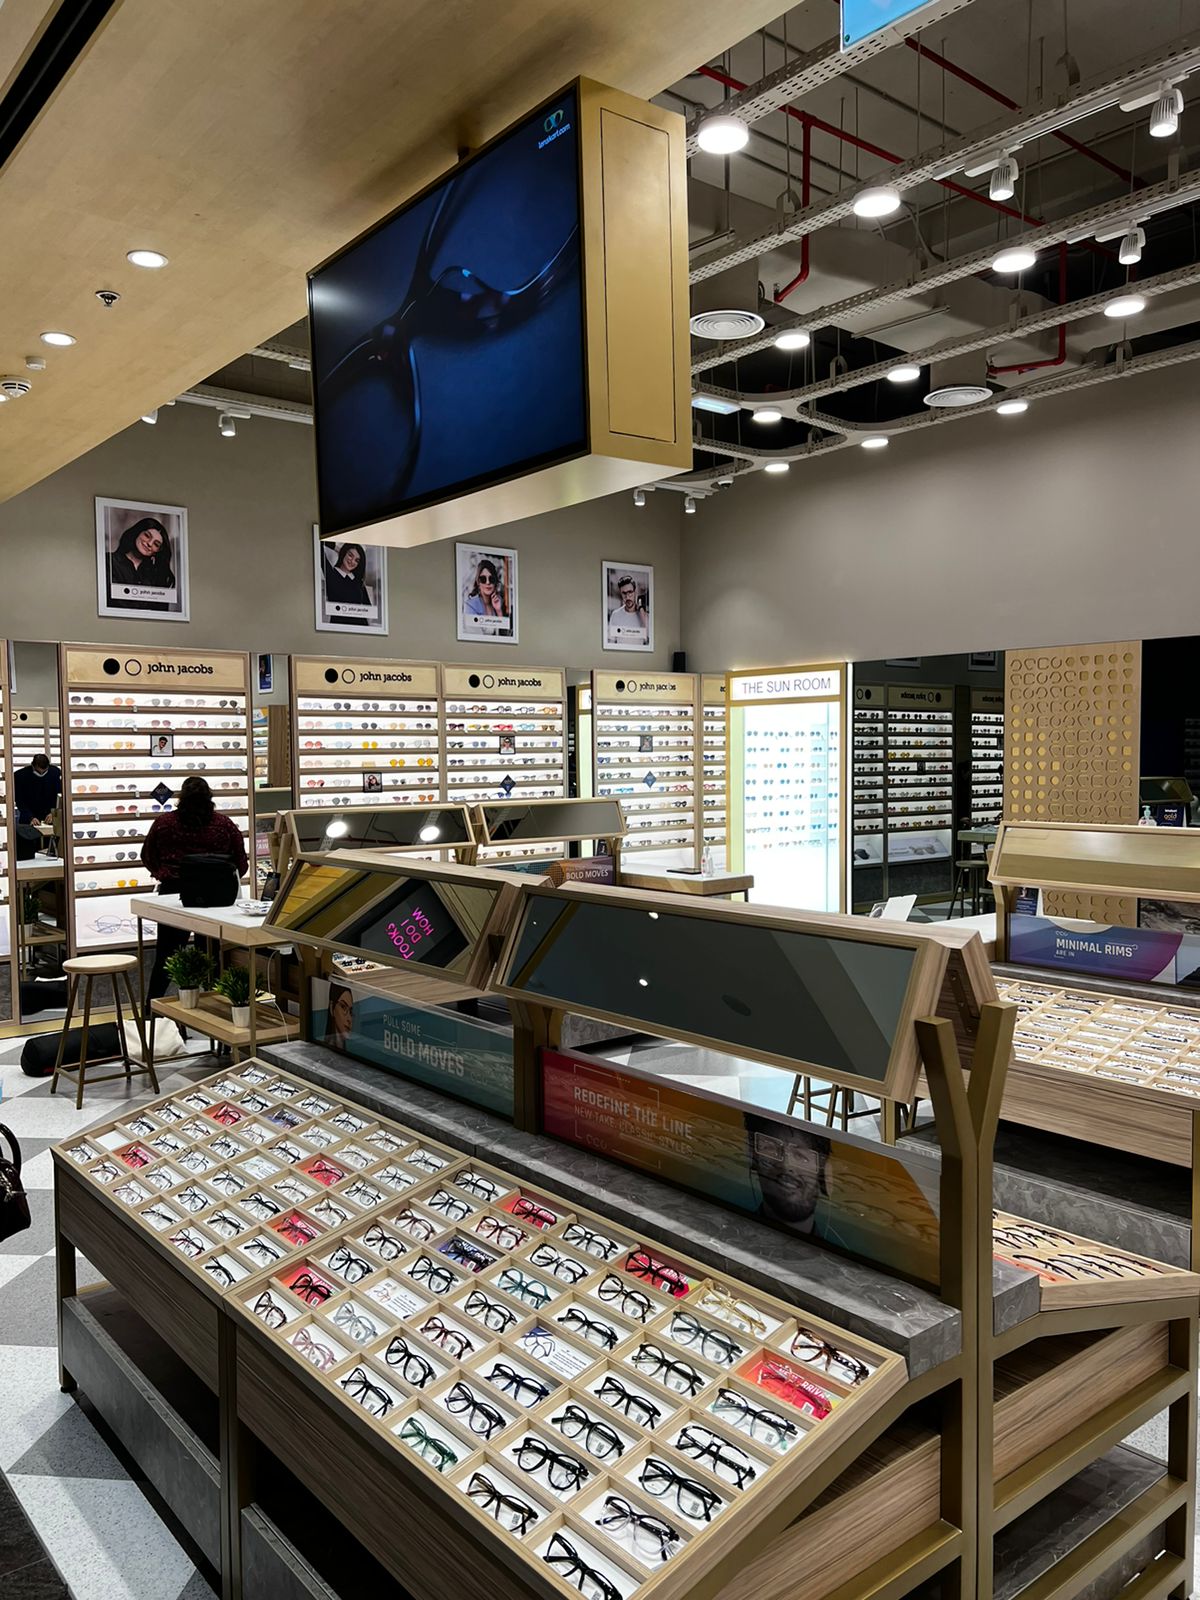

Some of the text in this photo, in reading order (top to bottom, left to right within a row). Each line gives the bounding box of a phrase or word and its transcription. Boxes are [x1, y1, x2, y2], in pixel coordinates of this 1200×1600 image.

[147, 662, 213, 675] john jacobs
[360, 671, 412, 683] john jacobs
[498, 677, 542, 687] john jacobs
[639, 682, 655, 692] john
[742, 677, 831, 694] THE SUN ROOM
[566, 869, 608, 880] BOLD MOVES
[1056, 938, 1133, 958] MINIMAL RIMS
[383, 1014, 422, 1036] PULL SOME
[383, 1029, 465, 1077] BOLD MOVES
[574, 1104, 593, 1119] NEW
[574, 1086, 694, 1140] REDEFINE THE LINE
